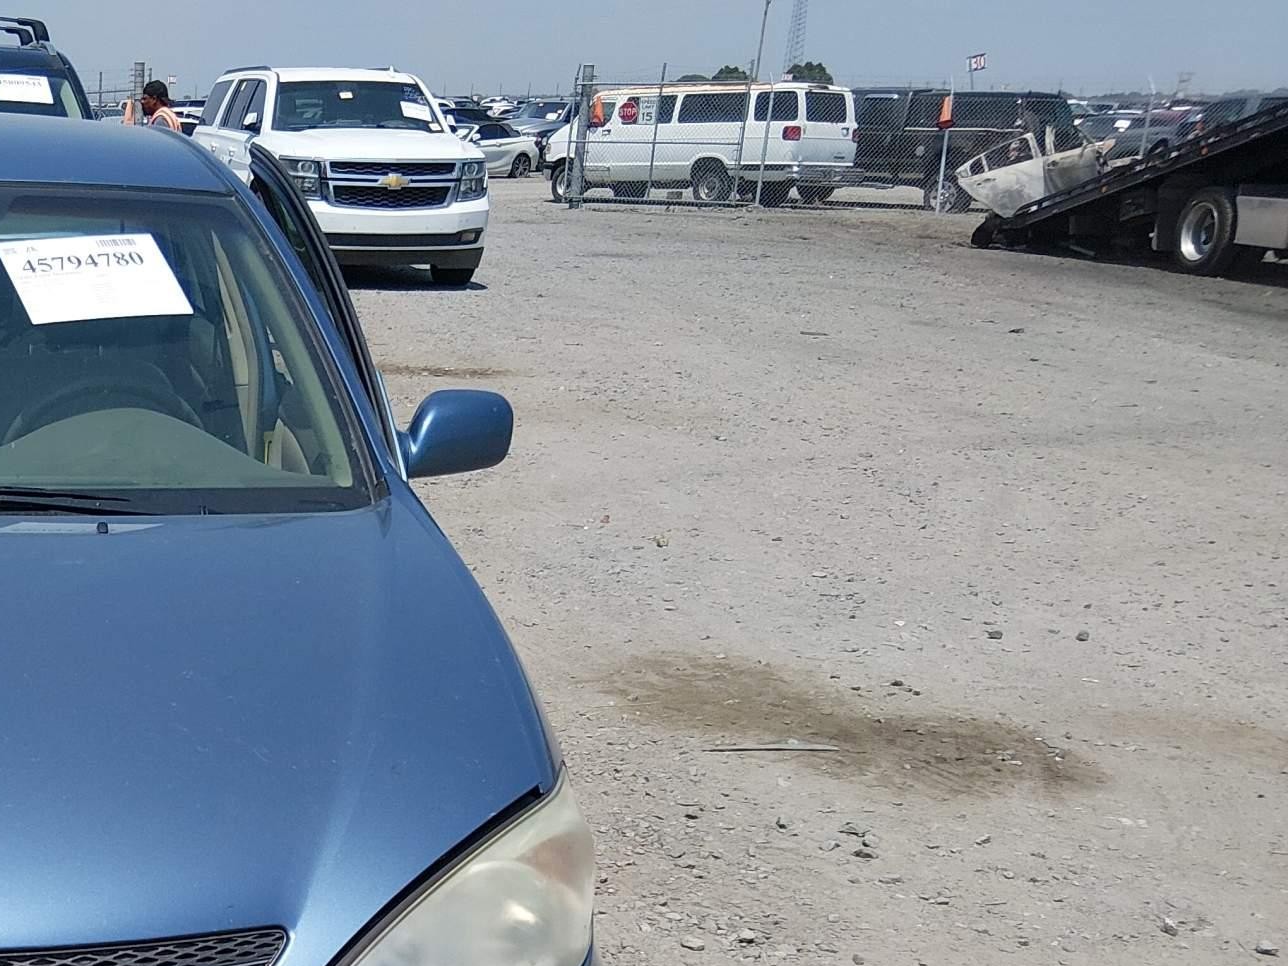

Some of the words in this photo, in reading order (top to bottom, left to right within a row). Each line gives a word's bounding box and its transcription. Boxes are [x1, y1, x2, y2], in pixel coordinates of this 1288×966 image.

[619, 107, 637, 117] STOP
[641, 112, 653, 121] 15
[21, 251, 144, 273] 45794780
